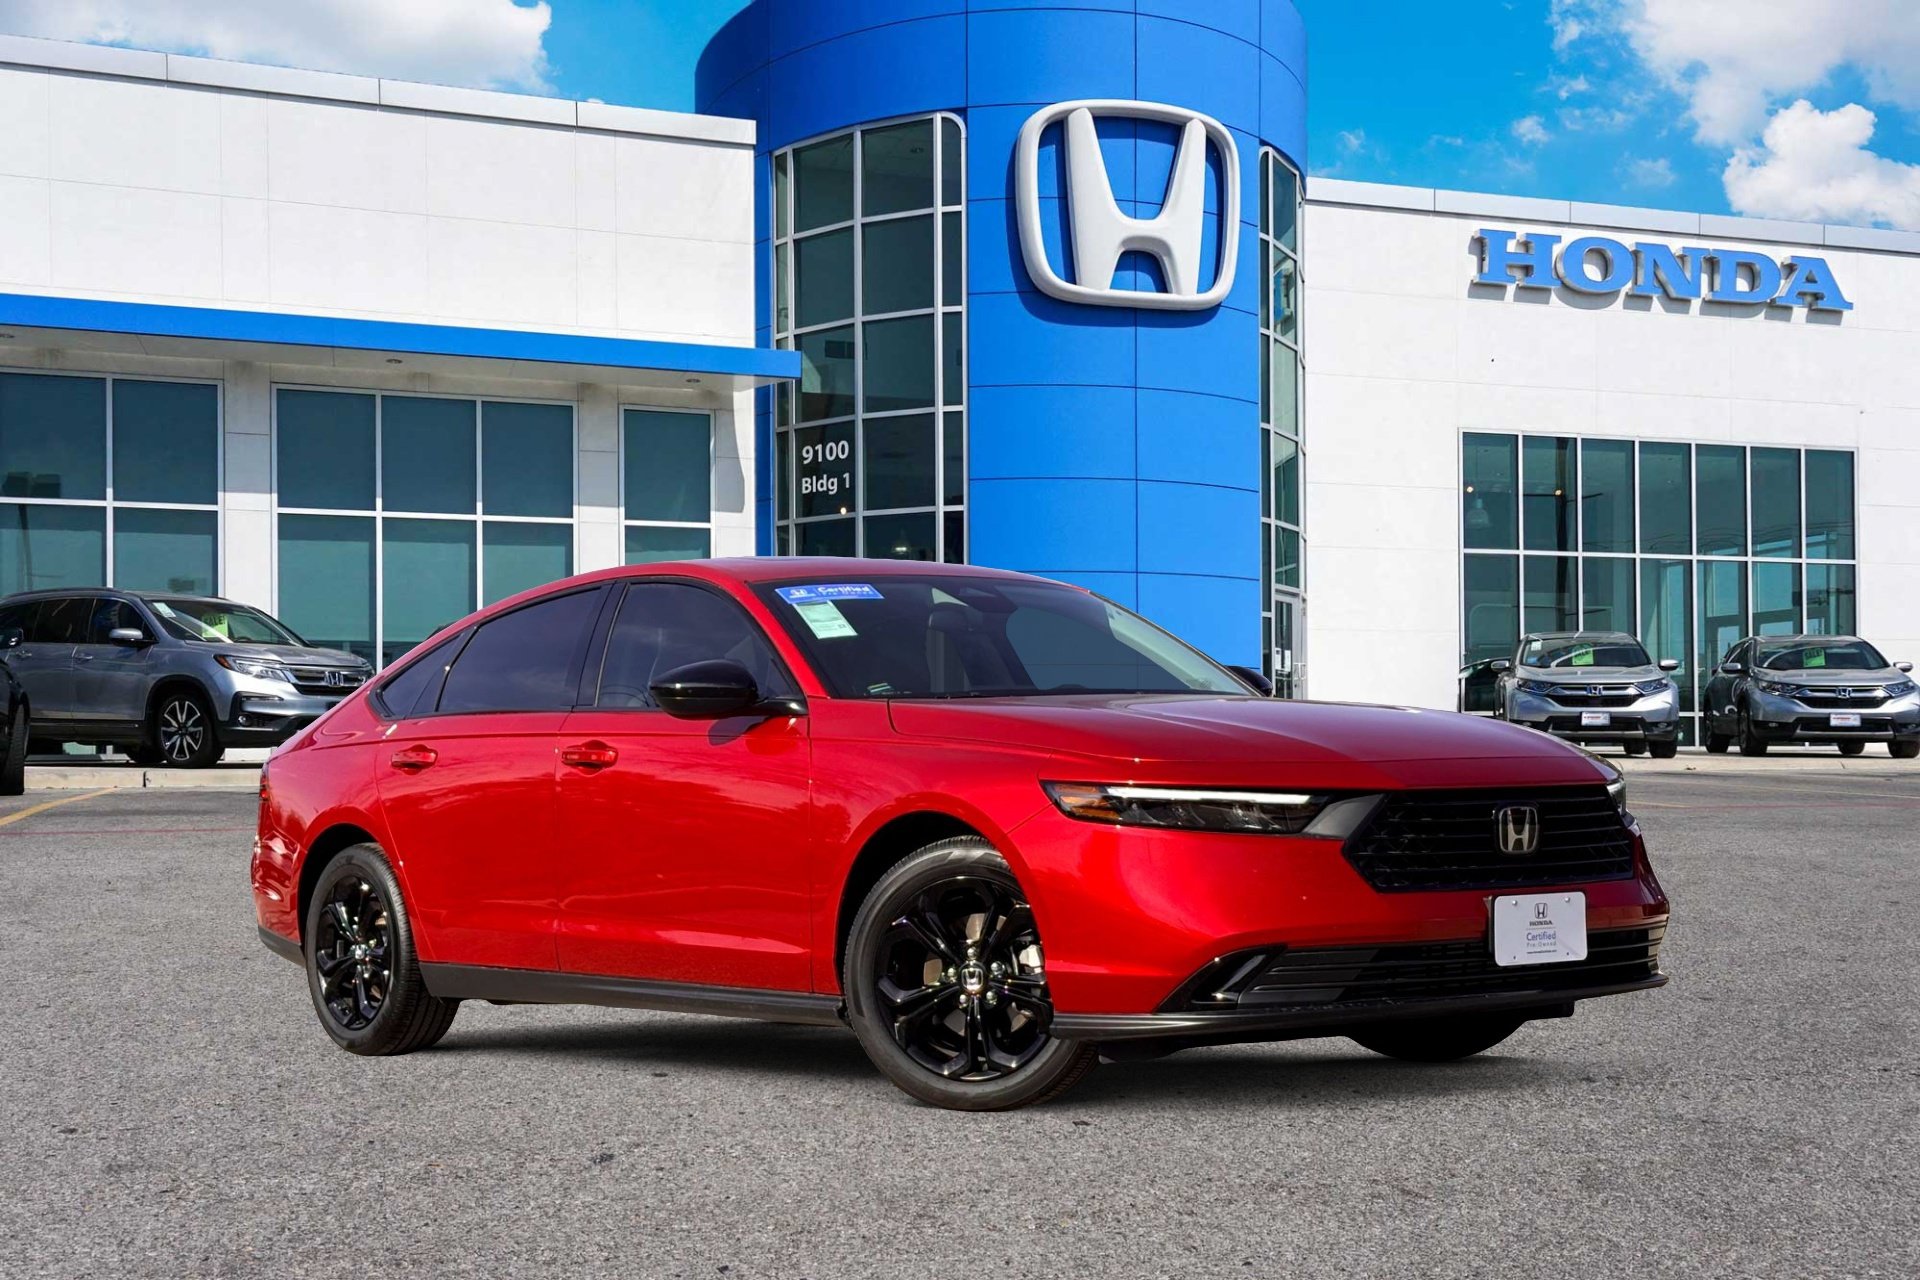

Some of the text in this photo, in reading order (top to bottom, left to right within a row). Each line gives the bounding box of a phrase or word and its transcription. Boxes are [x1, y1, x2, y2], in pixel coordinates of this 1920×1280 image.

[1473, 228, 1855, 312] HONDA
[801, 440, 849, 465] 9100
[801, 472, 850, 495] Bldg 1
[1526, 930, 1556, 941] Certified
